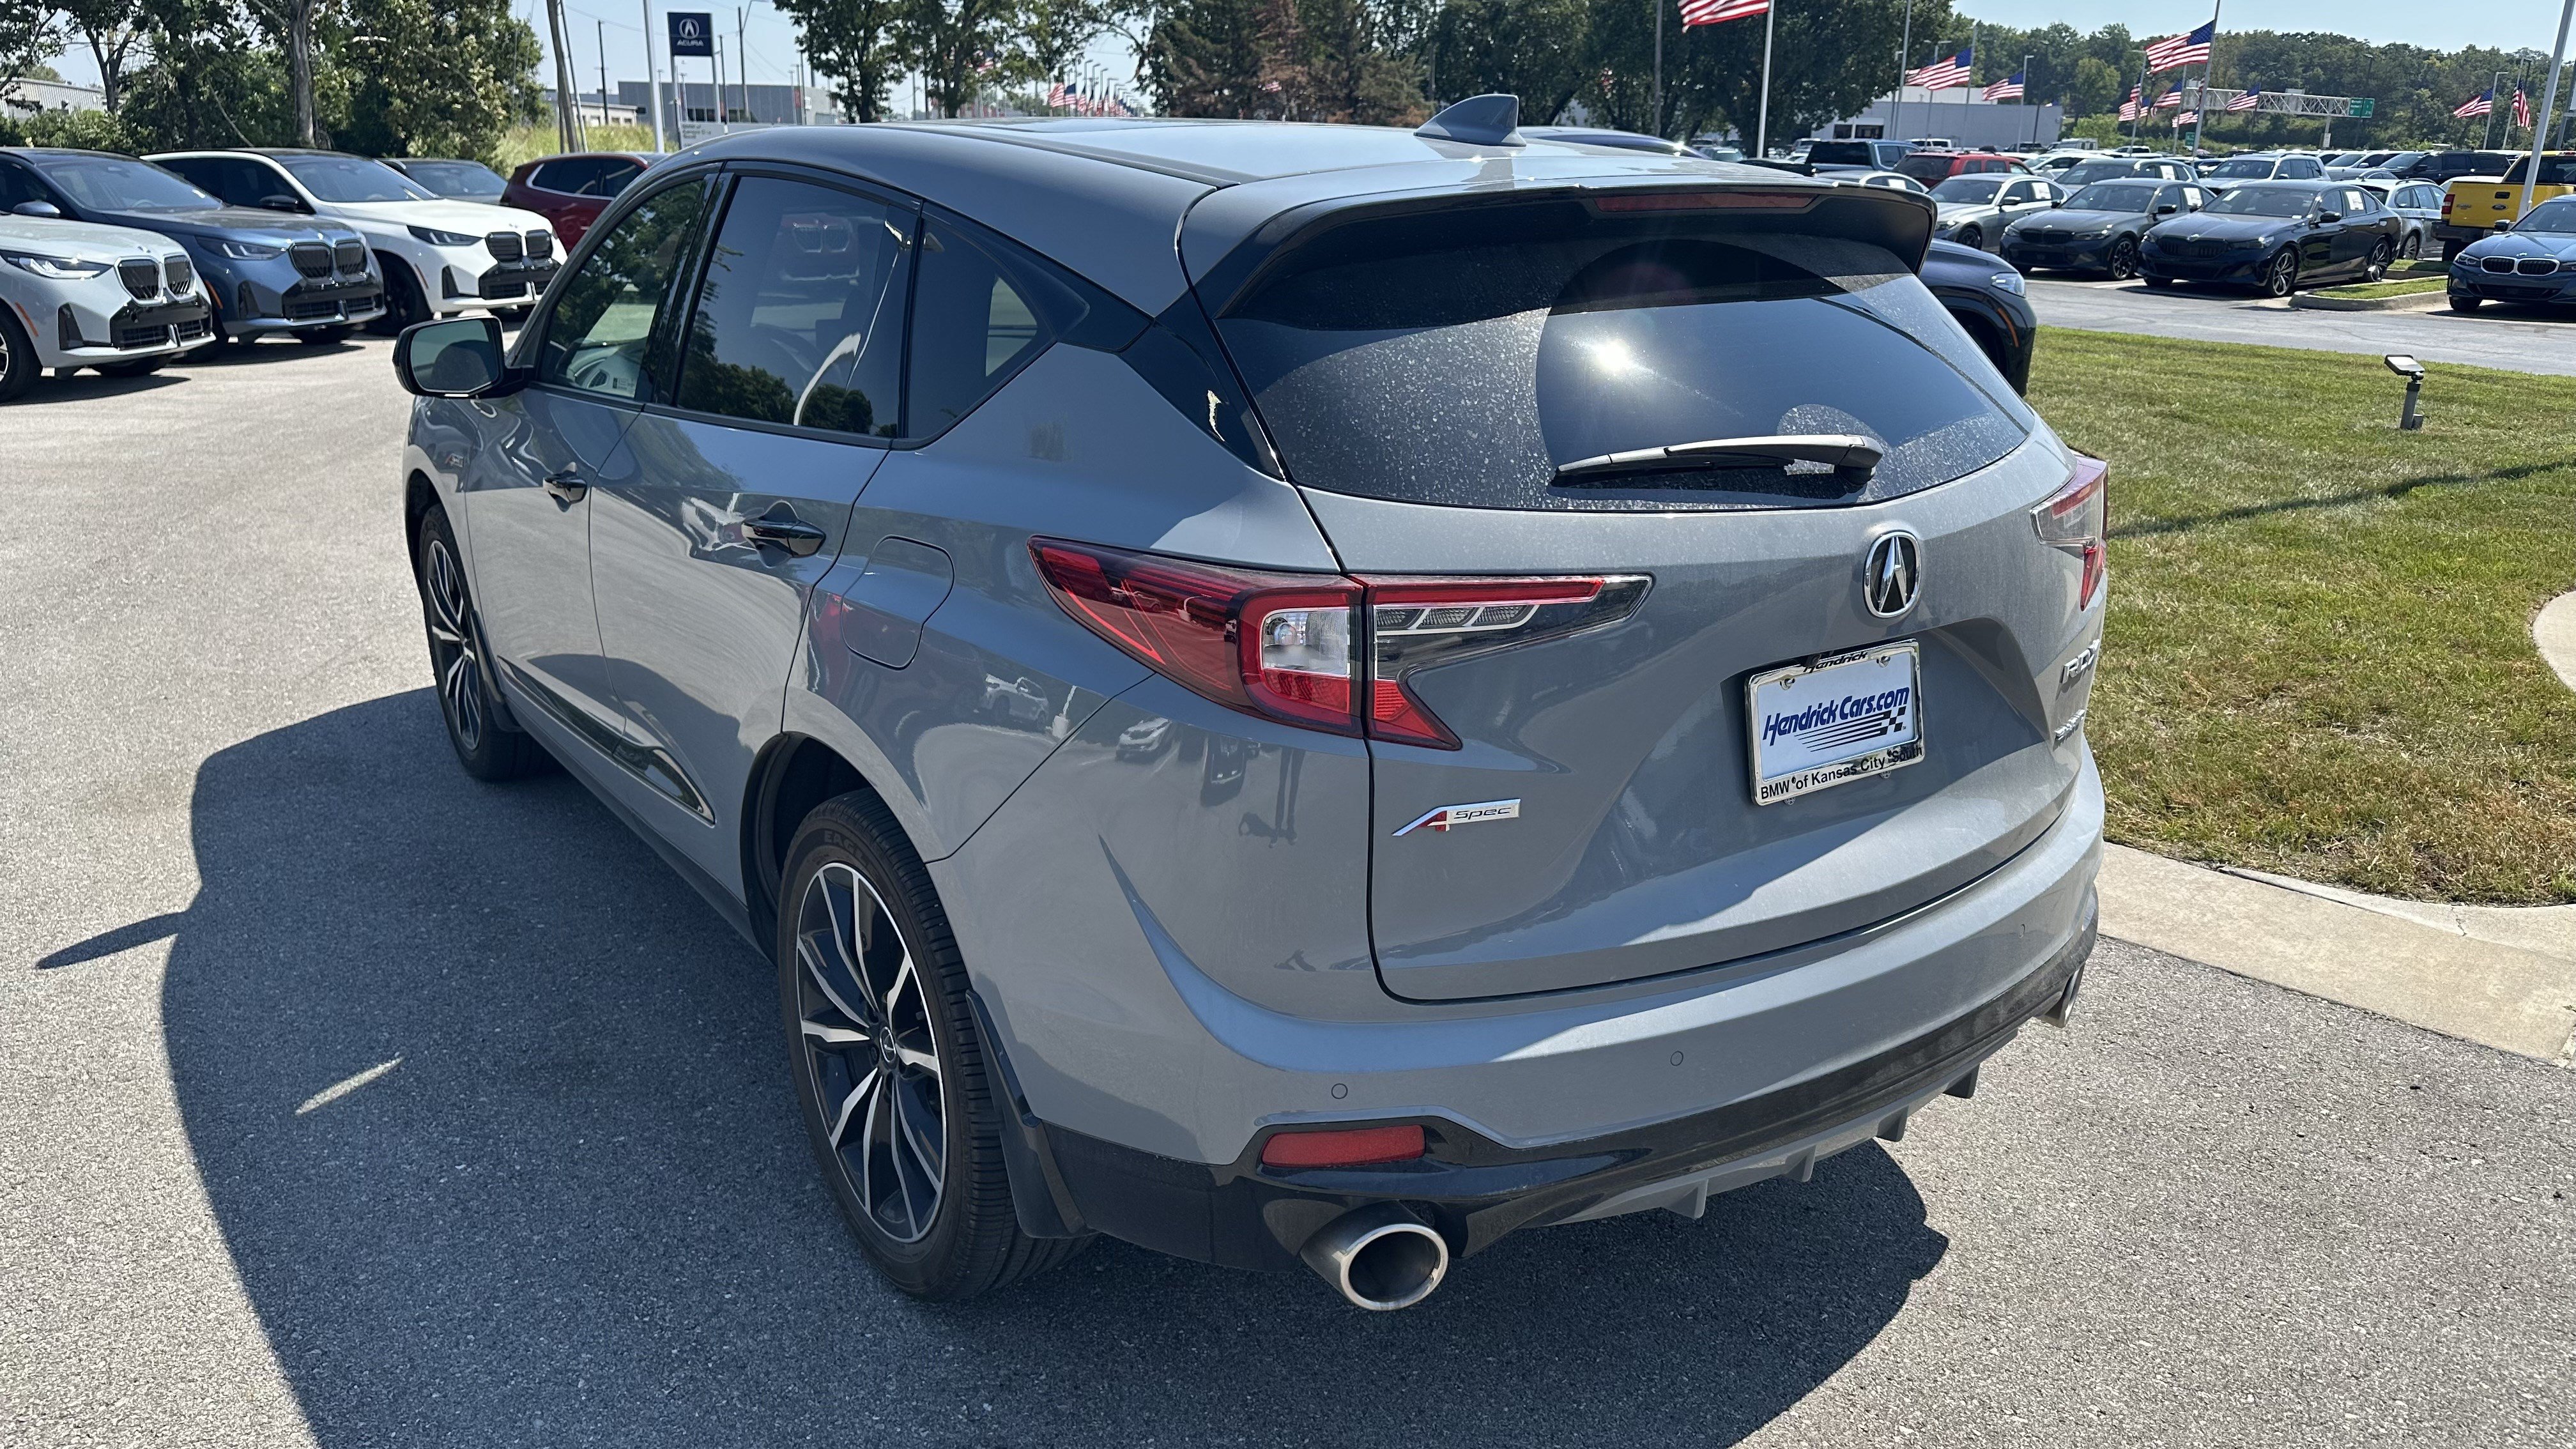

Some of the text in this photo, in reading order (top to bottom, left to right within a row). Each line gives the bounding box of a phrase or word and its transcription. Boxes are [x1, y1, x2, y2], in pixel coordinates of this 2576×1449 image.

[1761, 746, 1922, 799] BMW of Kansas City South
